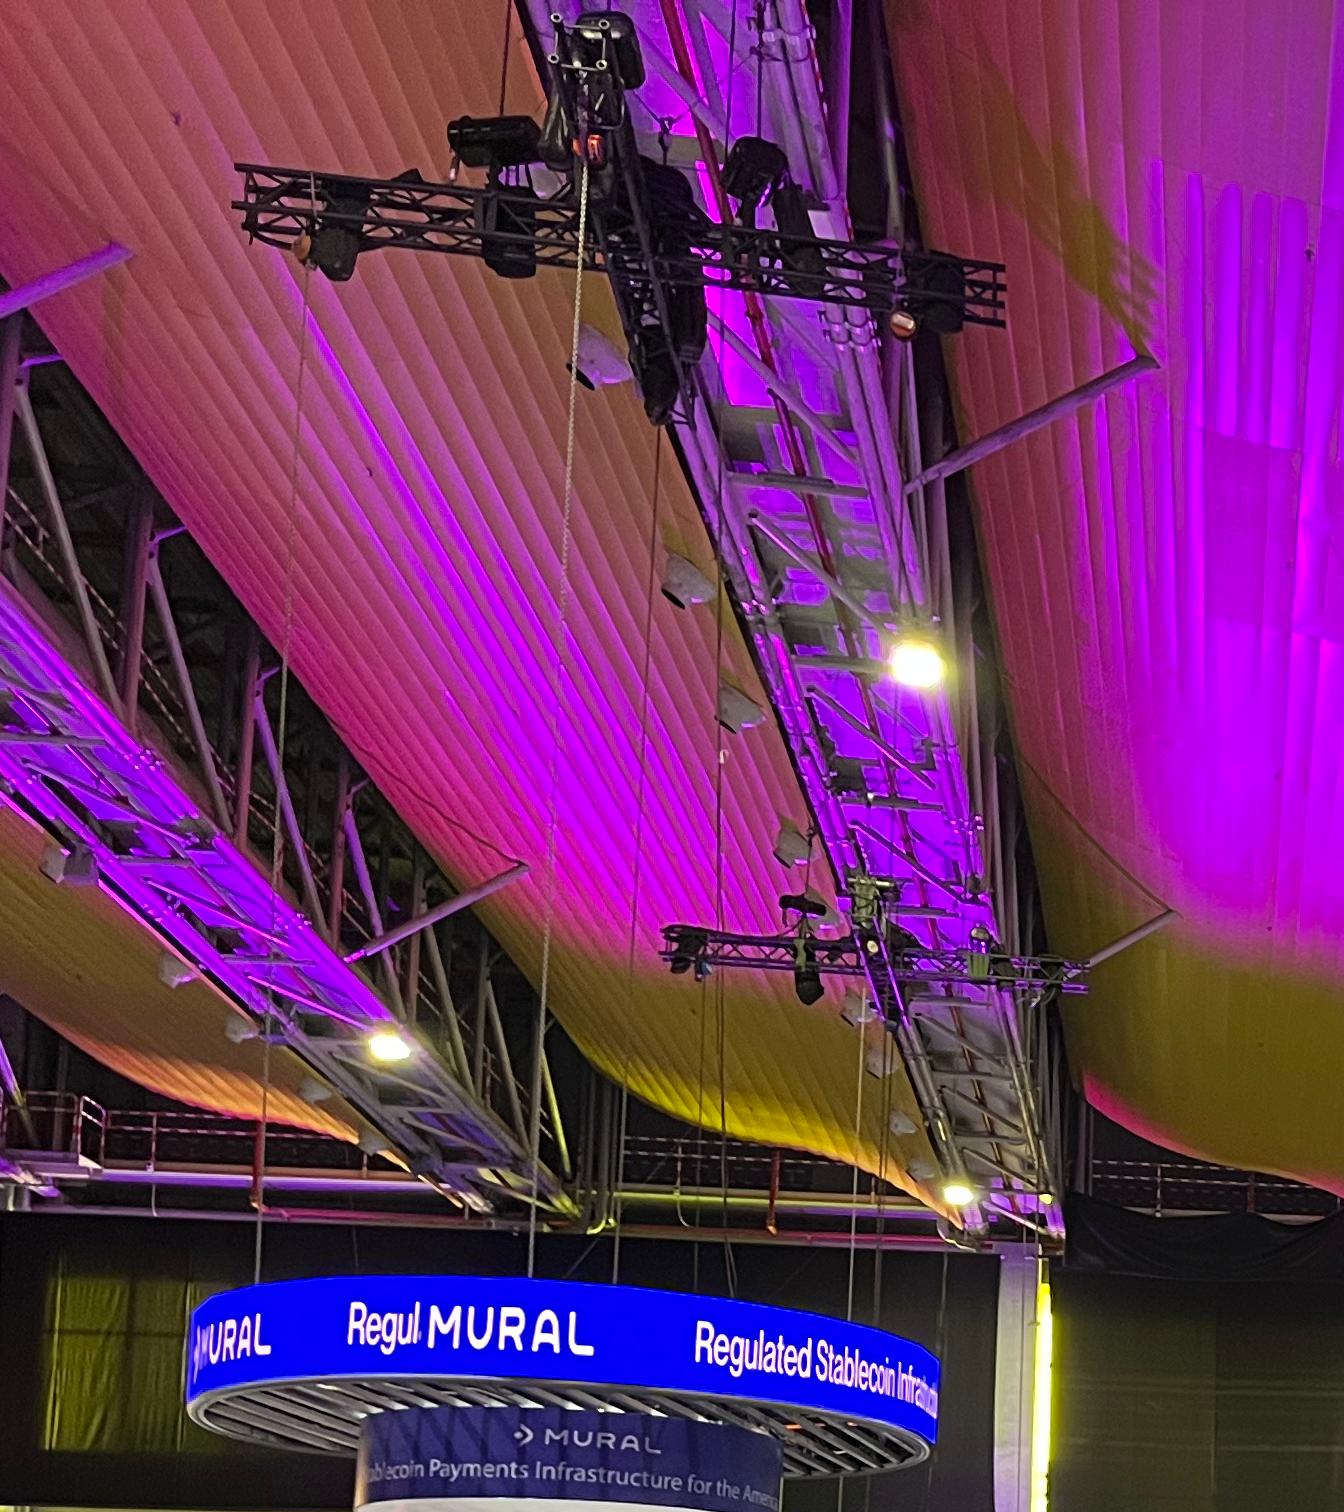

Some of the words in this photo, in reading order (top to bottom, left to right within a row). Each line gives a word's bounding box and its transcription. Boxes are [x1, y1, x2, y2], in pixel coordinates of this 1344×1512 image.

[427, 1304, 595, 1357] MURAL
[694, 1320, 813, 1379] Regulated
[815, 1339, 898, 1396] Stablecoin
[545, 1428, 662, 1454] MURAL
[430, 1458, 528, 1482] Payments
[535, 1461, 682, 1491] Infrastructure
[688, 1473, 713, 1495] for
[716, 1478, 740, 1500] the
